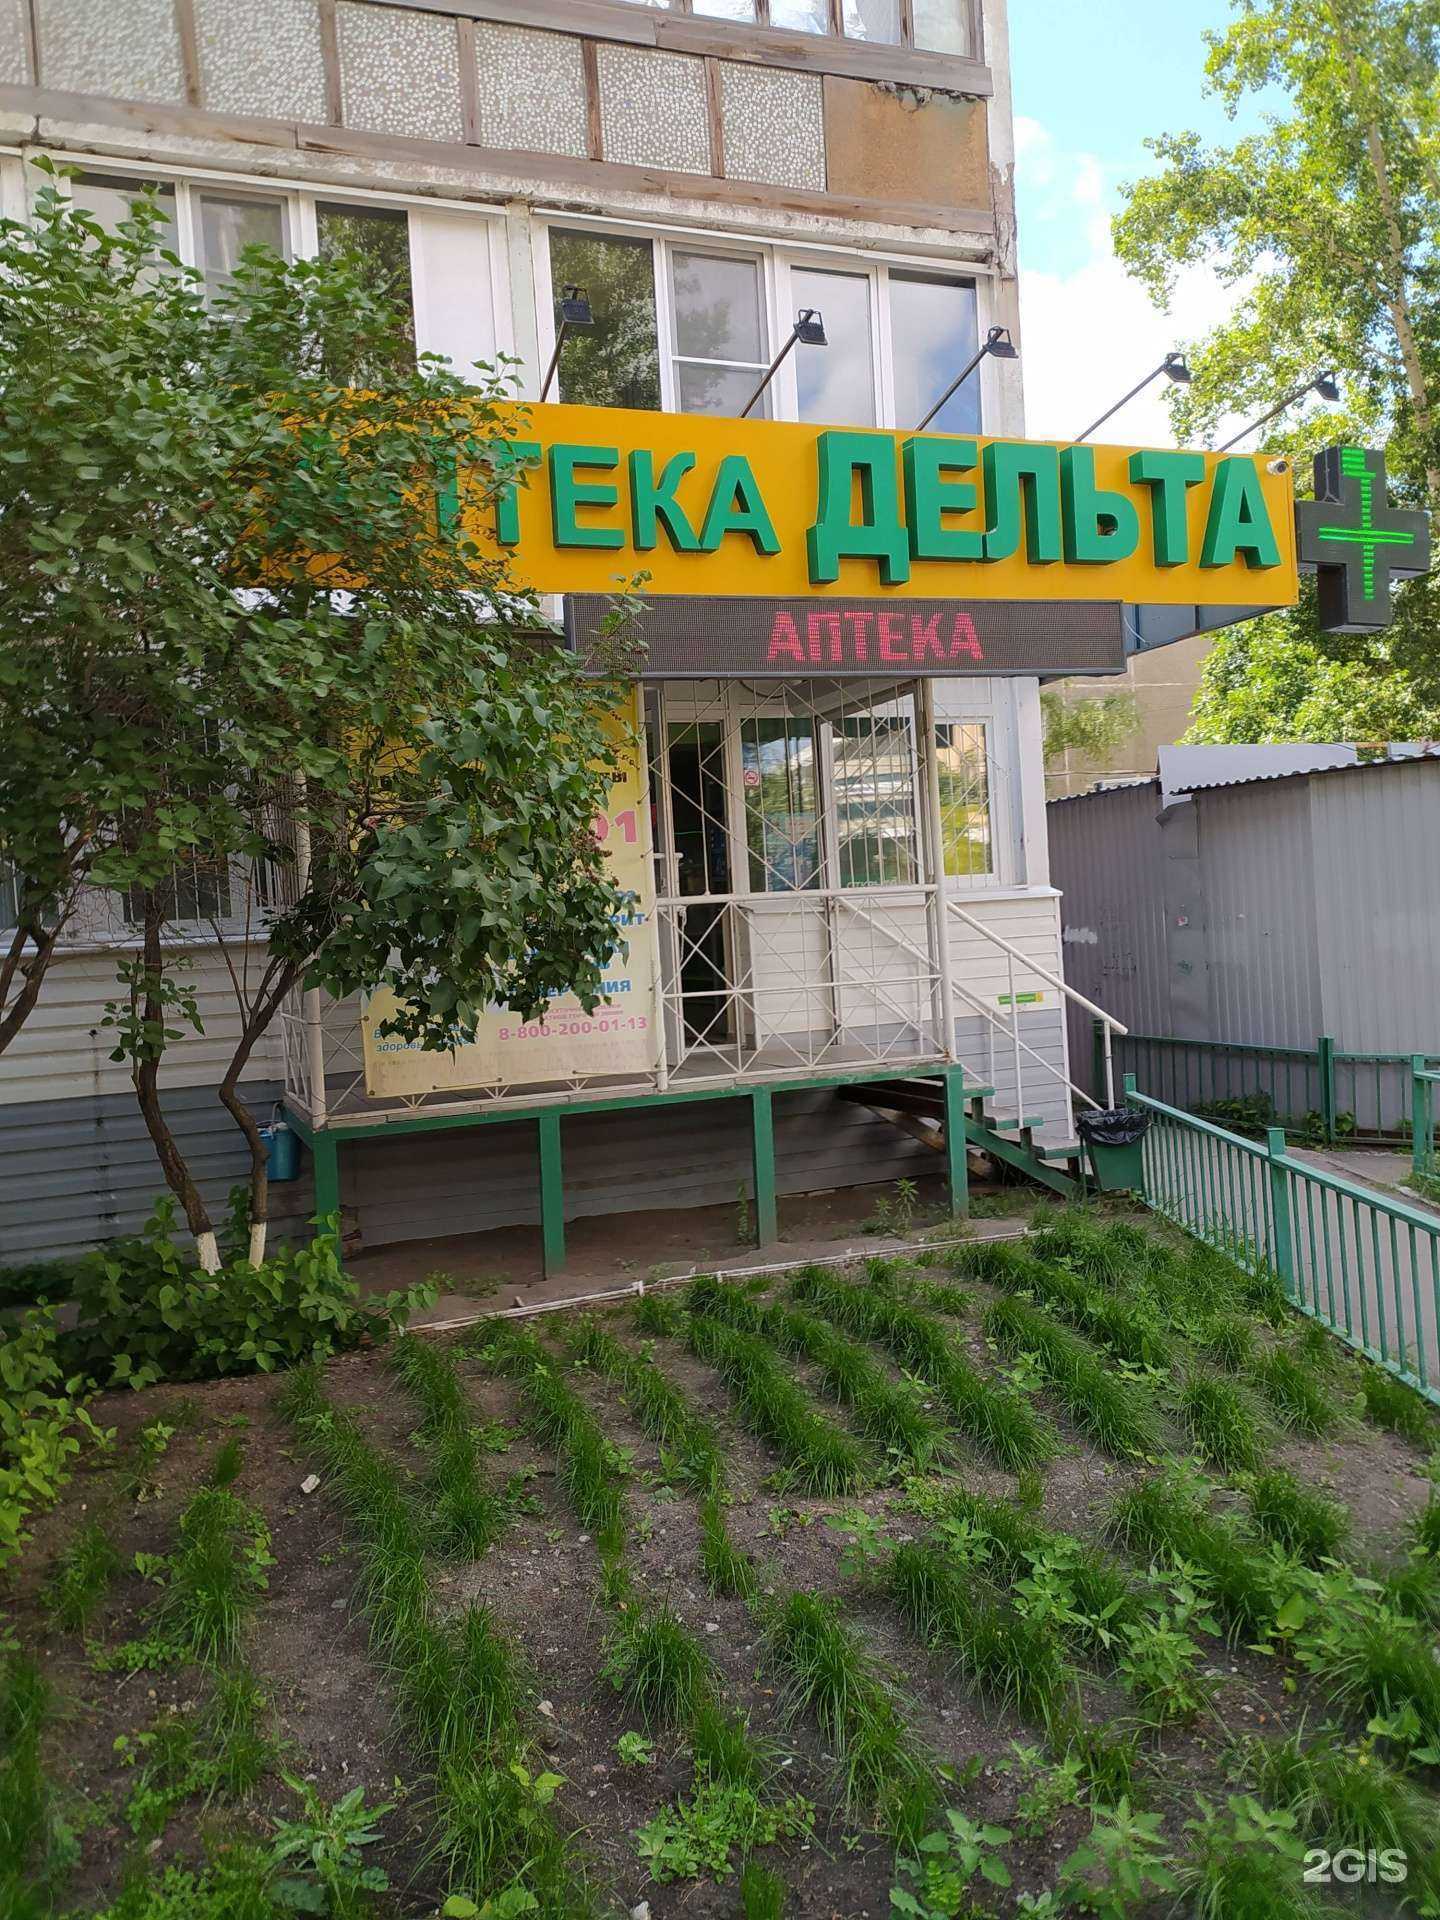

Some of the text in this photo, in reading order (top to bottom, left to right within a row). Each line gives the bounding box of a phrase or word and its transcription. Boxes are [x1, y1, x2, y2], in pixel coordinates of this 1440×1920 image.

[806, 431, 1283, 587] ДЕЛЬТА
[767, 610, 985, 662] АПТЕКА
[498, 1017, 648, 1041] 8-800-200-01-13
